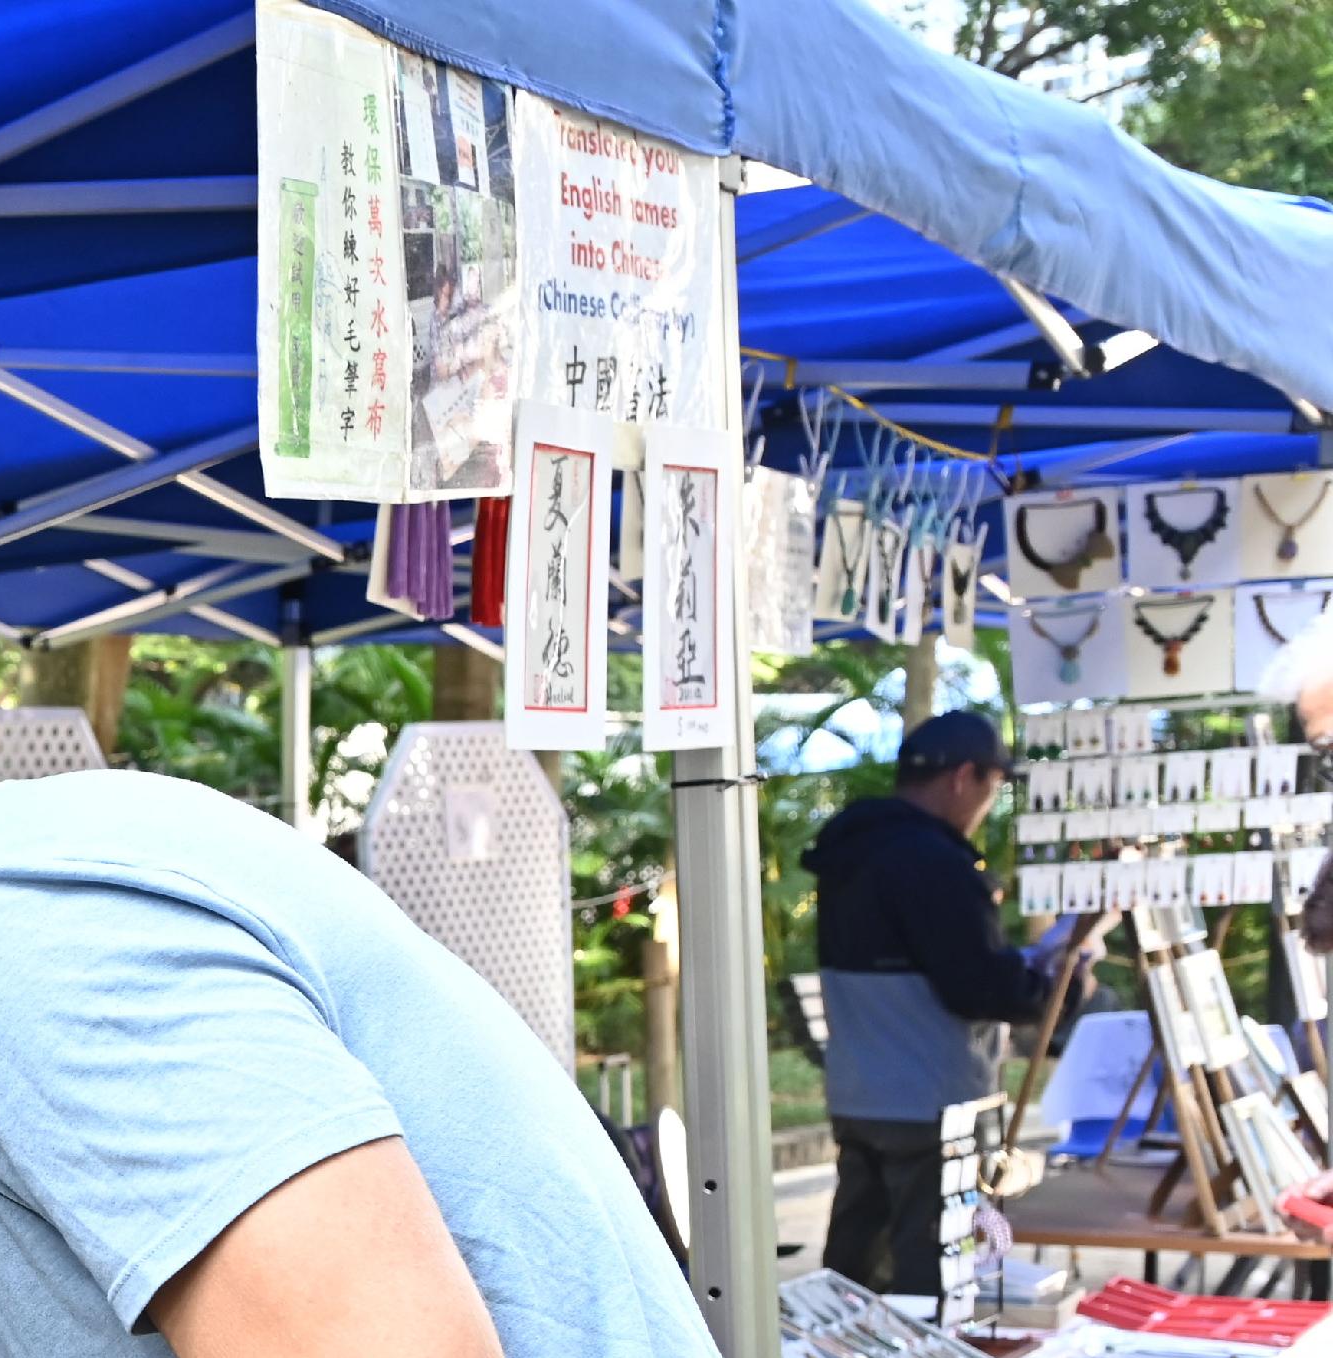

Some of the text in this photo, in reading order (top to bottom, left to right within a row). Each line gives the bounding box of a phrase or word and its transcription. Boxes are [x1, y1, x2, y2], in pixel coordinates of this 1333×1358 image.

[561, 171, 622, 220] English
[571, 231, 667, 281] into Chines
[340, 139, 361, 442] 教你練好毛筆字
[538, 277, 607, 318] (Chinese
